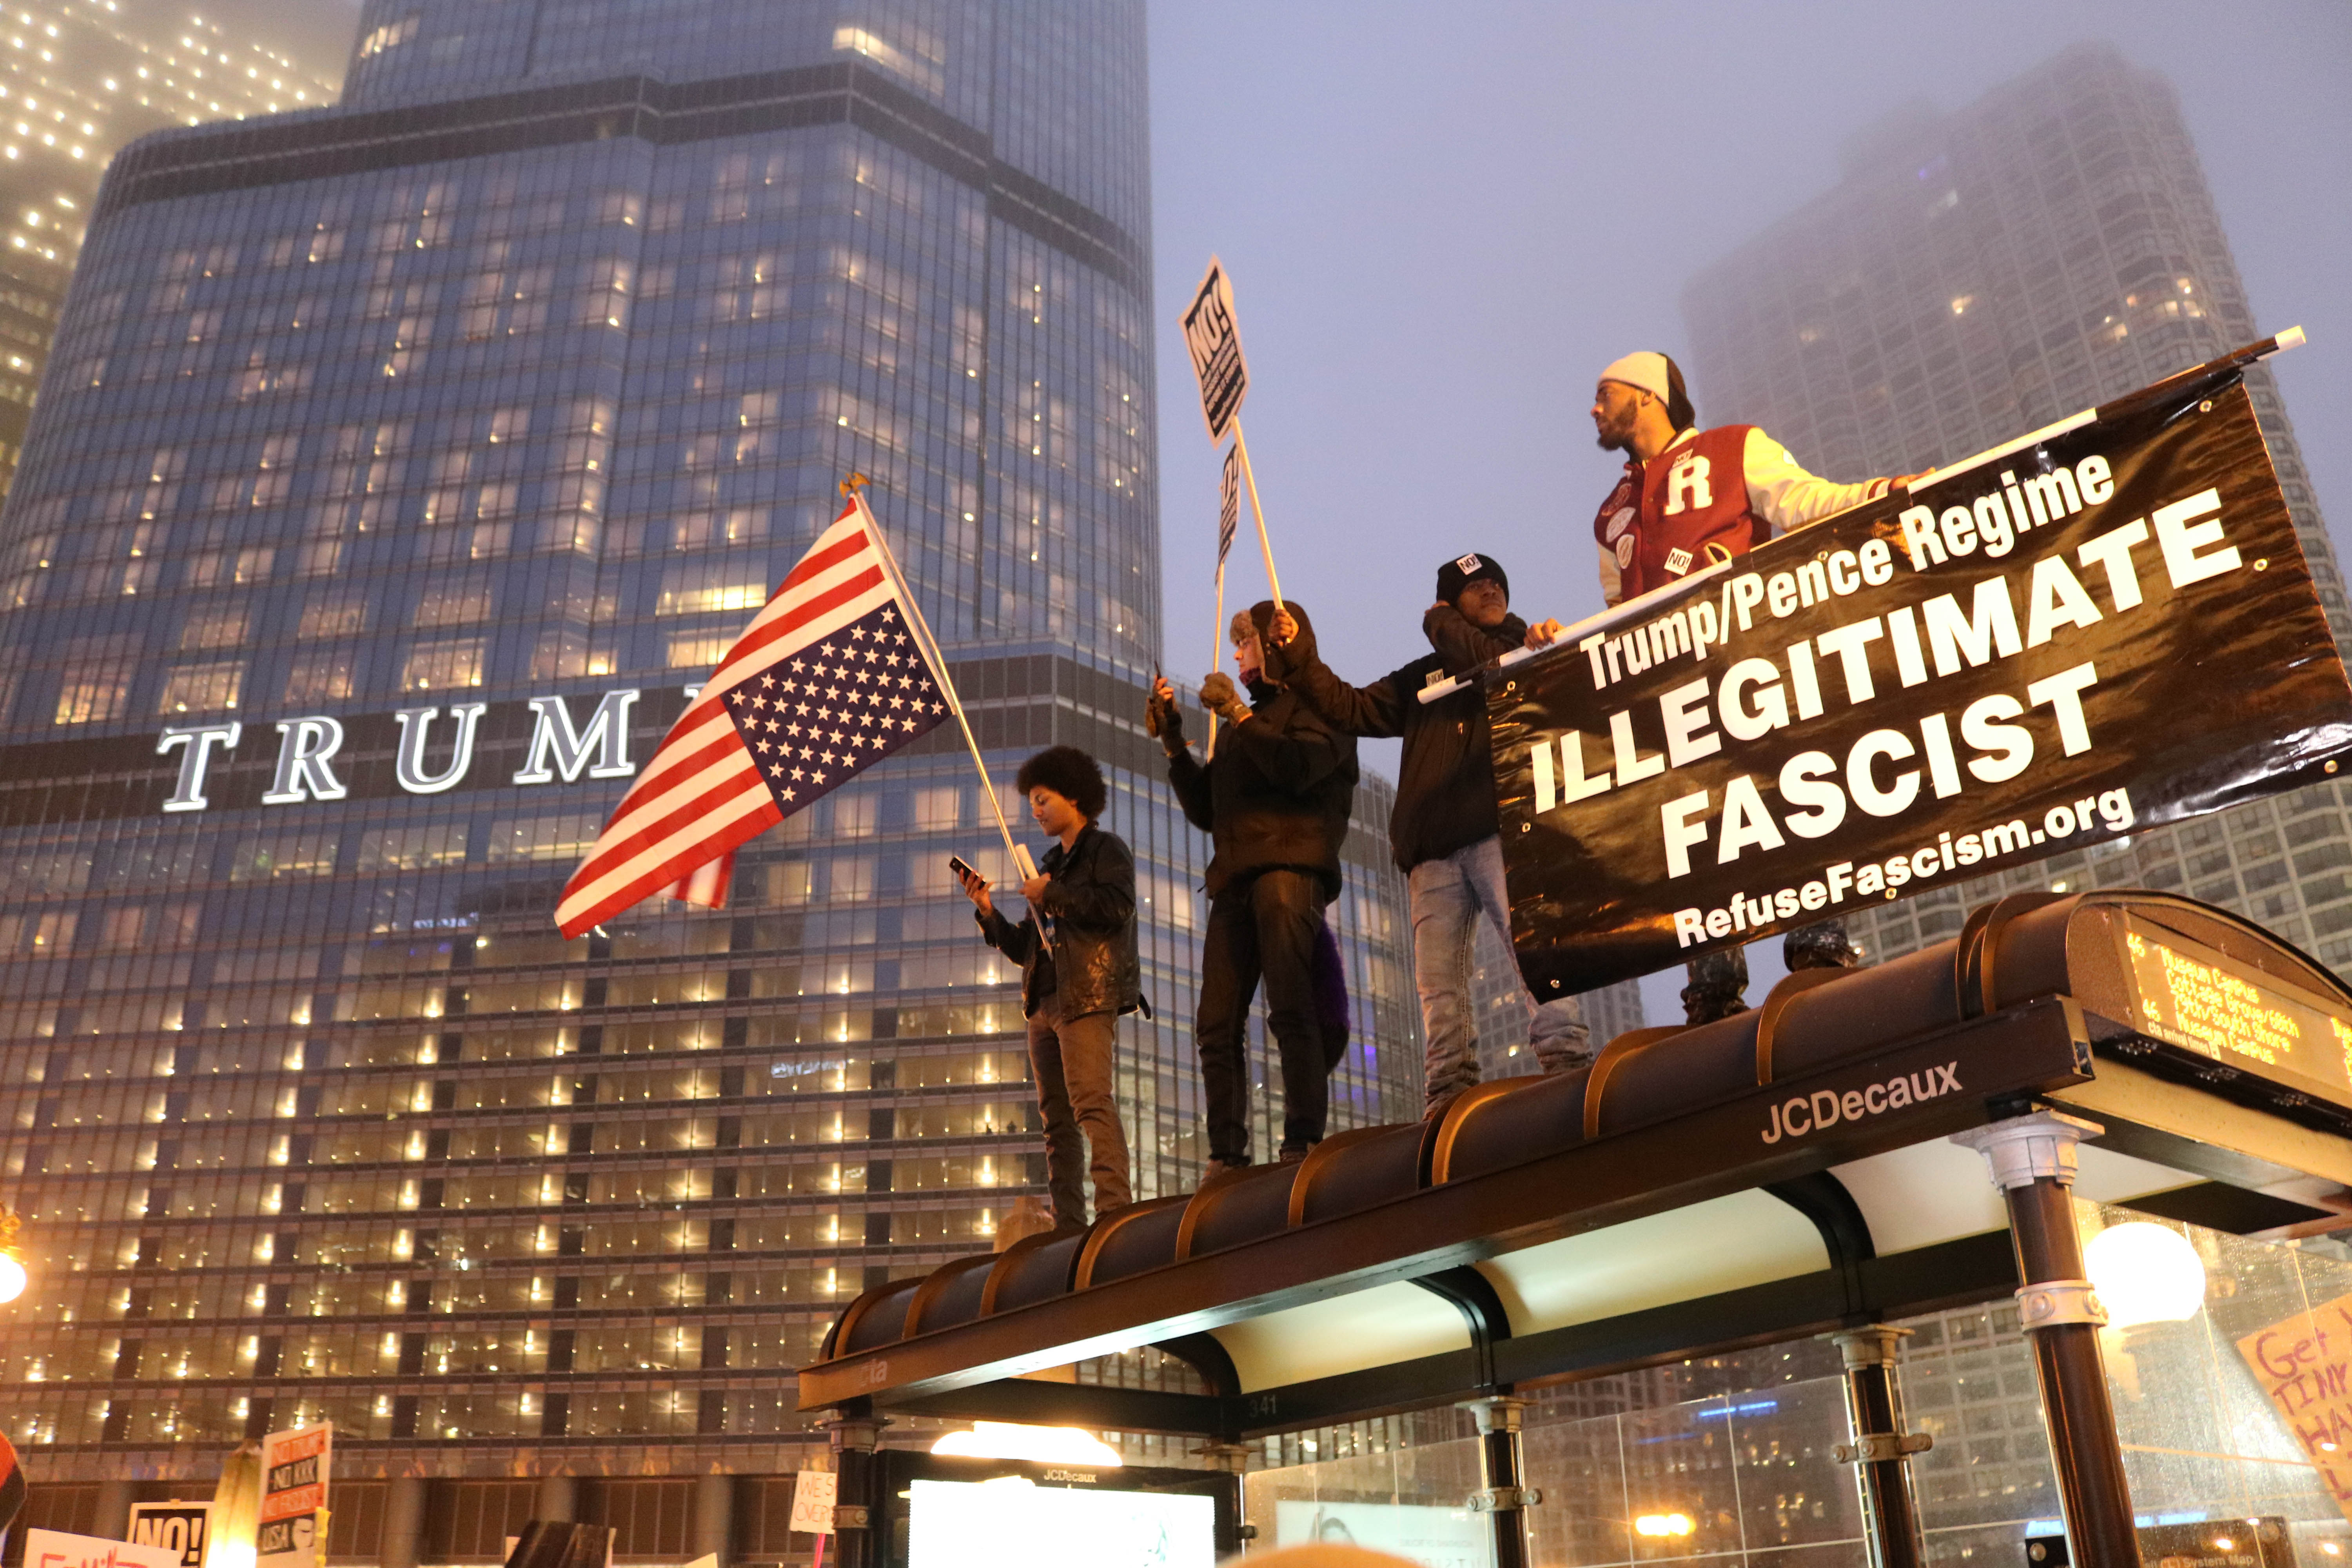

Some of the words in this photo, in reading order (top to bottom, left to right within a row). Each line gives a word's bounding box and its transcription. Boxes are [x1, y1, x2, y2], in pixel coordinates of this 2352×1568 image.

[1189, 279, 1229, 376] NO!
[1664, 455, 1712, 515] R
[1460, 556, 1478, 570] NO!
[1580, 538, 1893, 690] Trump/Pence
[1899, 455, 2114, 572] Regime
[1668, 552, 1690, 569] NO!
[1531, 488, 2242, 814] ILLEGITIMATE
[157, 684, 706, 811] TRUM
[1661, 661, 2098, 879] FASCIST
[1673, 788, 2137, 948] RefuseFascism.org
[2161, 946, 2211, 984] Museum
[2213, 968, 2259, 1004] Campus
[2166, 968, 2223, 1007] Cottage
[2148, 1021, 2163, 1038] cta
[2163, 1029, 2188, 1047] arrival
[2188, 1035, 2210, 1054] times
[2176, 1011, 2227, 1048] Museum
[2229, 1031, 2275, 1065] Campus
[2253, 1021, 2290, 1053] Shore
[1761, 1061, 1963, 1144] JCDecaux
[2256, 1327, 2328, 1379] Get
[2273, 1362, 2347, 1416] TINY
[2296, 1402, 2352, 1456] HA
[274, 1465, 291, 1490] NO
[294, 1457, 316, 1486] KKK
[800, 1475, 822, 1498] WE
[1044, 1470, 1096, 1483] JCDecaux
[136, 1516, 202, 1563] NO!
[2183, 1557, 2226, 1568] System
[2228, 1555, 2253, 1565] Map
